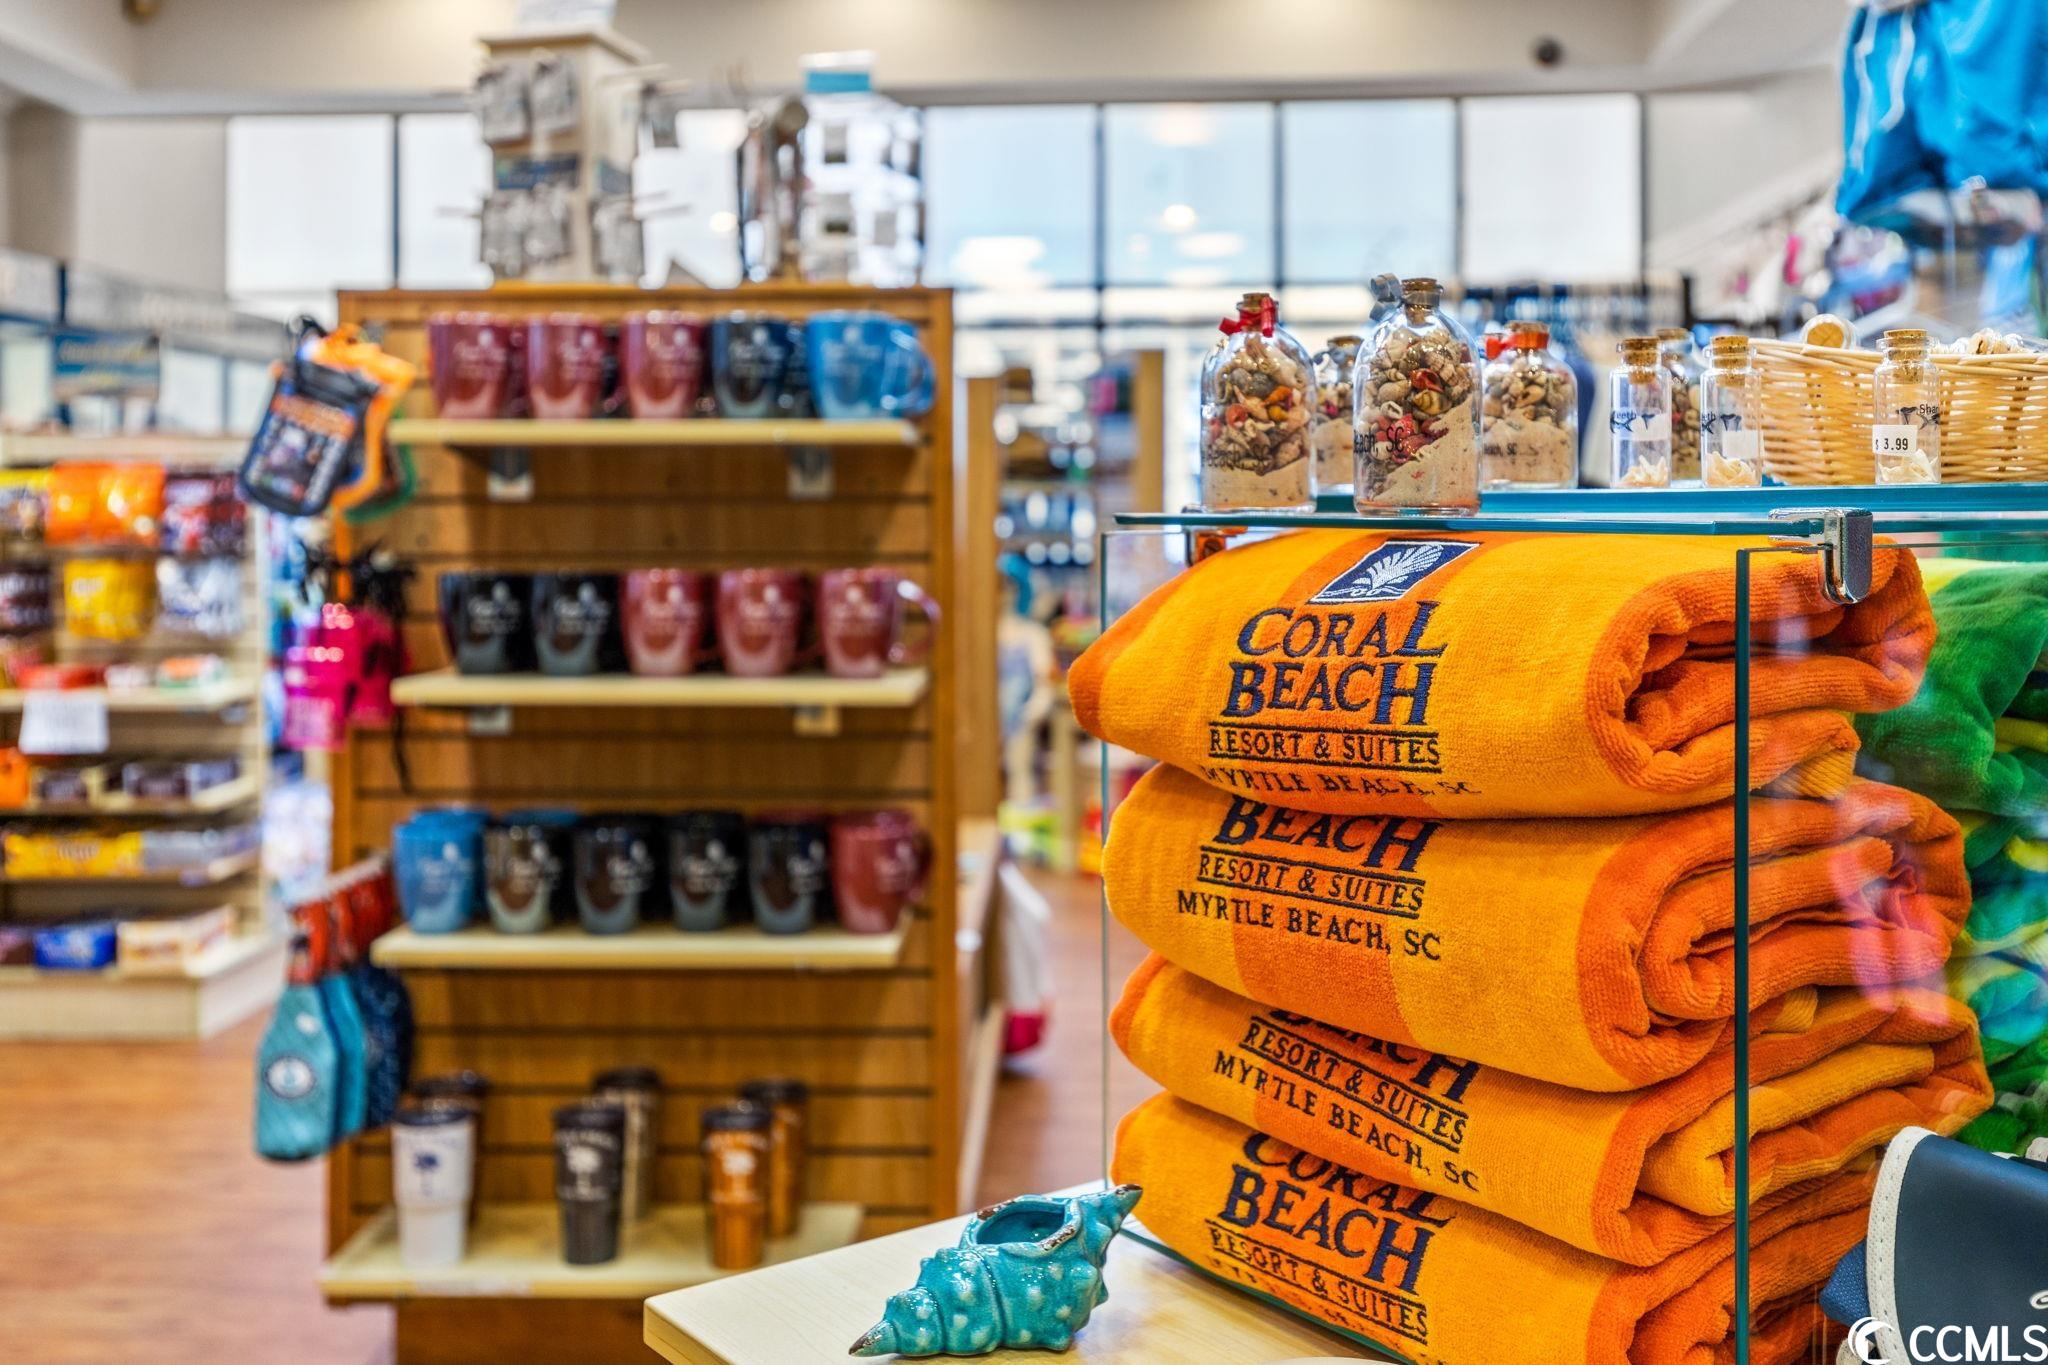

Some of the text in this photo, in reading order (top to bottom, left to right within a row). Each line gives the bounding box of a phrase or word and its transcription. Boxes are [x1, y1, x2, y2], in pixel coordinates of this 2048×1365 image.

[1386, 426, 1404, 452] SC
[1883, 437, 1909, 451] 3.99
[1237, 600, 1448, 658] CORAL
[1220, 661, 1437, 725] BEACH
[1208, 729, 1440, 765] RESORT & SUITES
[1212, 794, 1442, 873] BEACH
[1199, 853, 1424, 912] RESORT & SUITES
[1177, 889, 1441, 961] MYRTLE BEACH, SC
[1242, 1022, 1341, 1082] RESORT
[1345, 1068, 1365, 1095] &
[1372, 1080, 1467, 1145] SUITES
[1213, 1050, 1316, 1117] MYRTLE
[1443, 1160, 1480, 1192] SC
[1217, 1163, 1436, 1297] BEACH
[1209, 1226, 1300, 1284] RESORT
[1311, 1268, 1328, 1297] &
[1338, 1280, 1429, 1338] SUITES
